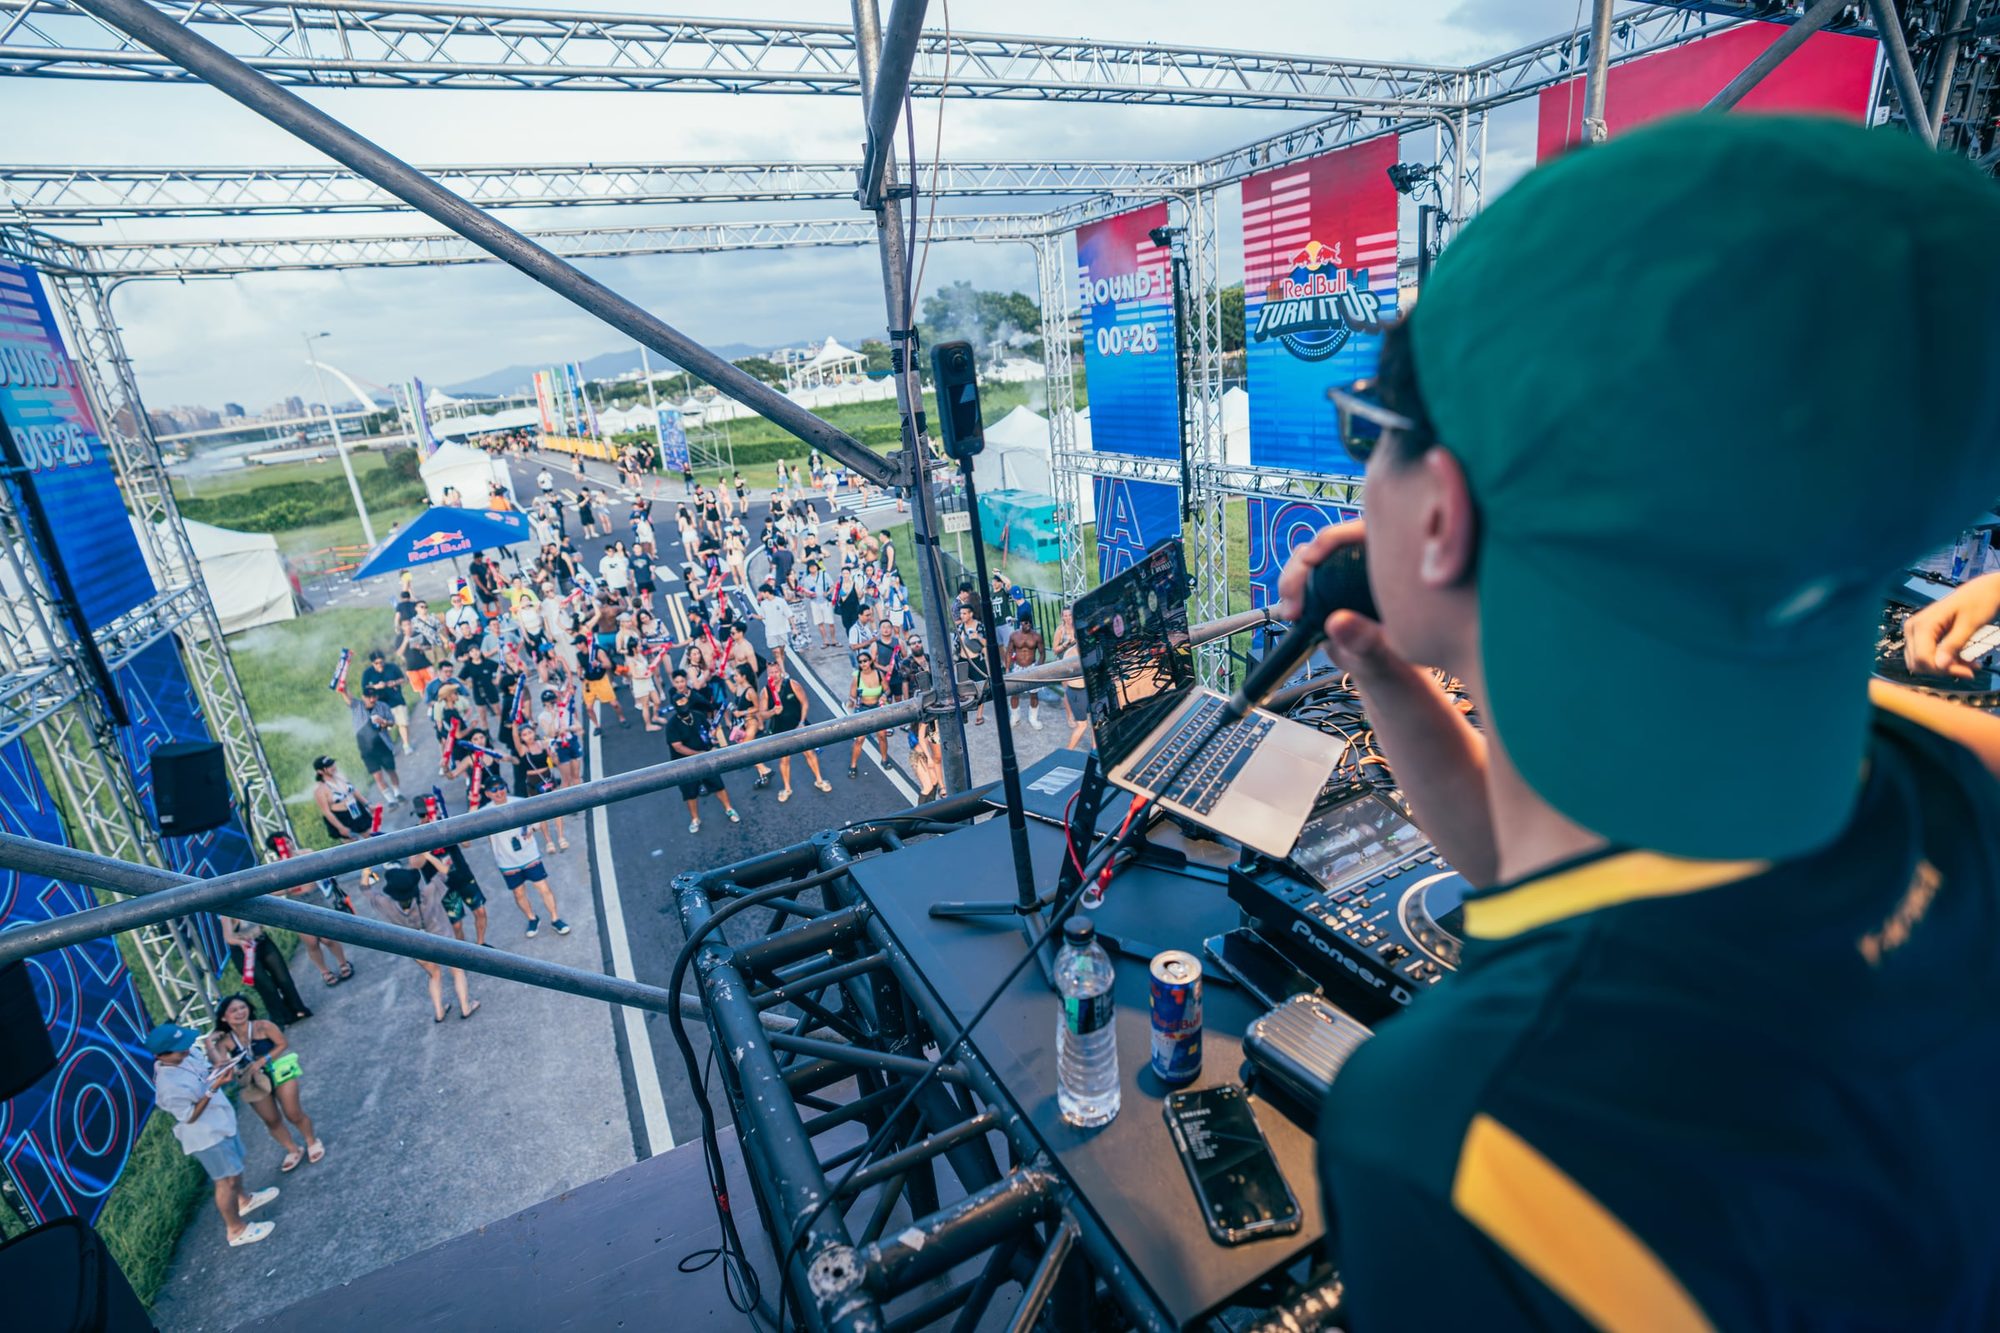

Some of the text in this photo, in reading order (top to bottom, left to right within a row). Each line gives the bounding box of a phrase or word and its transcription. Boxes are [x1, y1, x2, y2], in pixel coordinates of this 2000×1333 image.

[1084, 271, 1153, 306] ROUND
[1284, 269, 1347, 299] Red Bull
[1255, 283, 1379, 335] TURN IT UP
[1097, 322, 1158, 356] 00:26
[10, 423, 93, 474] 00:26
[408, 538, 472, 562] Red Bull
[1291, 919, 1386, 988] Pioneer
